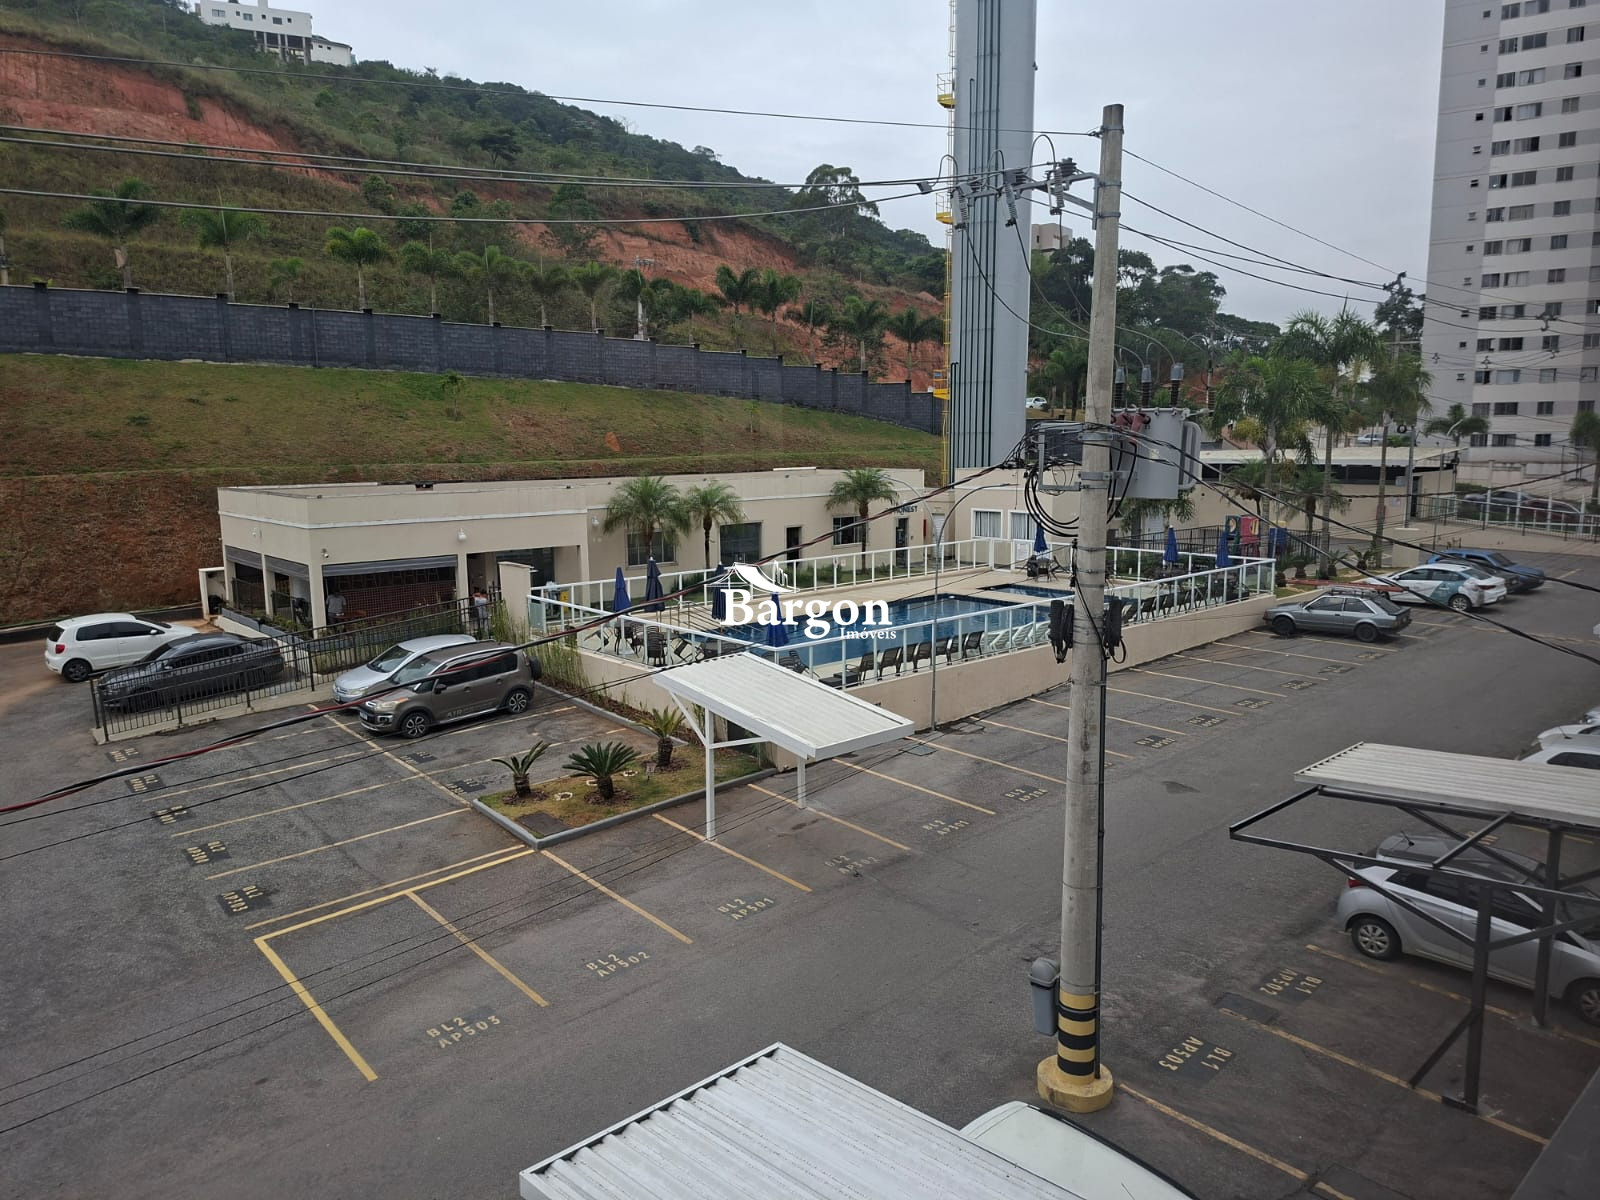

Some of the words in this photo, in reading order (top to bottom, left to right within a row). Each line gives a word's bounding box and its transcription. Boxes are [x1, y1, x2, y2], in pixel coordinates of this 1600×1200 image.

[716, 897, 748, 915] BL2
[730, 896, 775, 921] AP501
[584, 952, 621, 972] BL2
[595, 950, 652, 979] AP502
[1259, 967, 1299, 996] AP502
[1295, 975, 1323, 995] BL1
[425, 1015, 468, 1039] BL2
[436, 1014, 502, 1049] AP503
[1158, 1035, 1204, 1071] AP503
[1200, 1046, 1233, 1071] BL1
